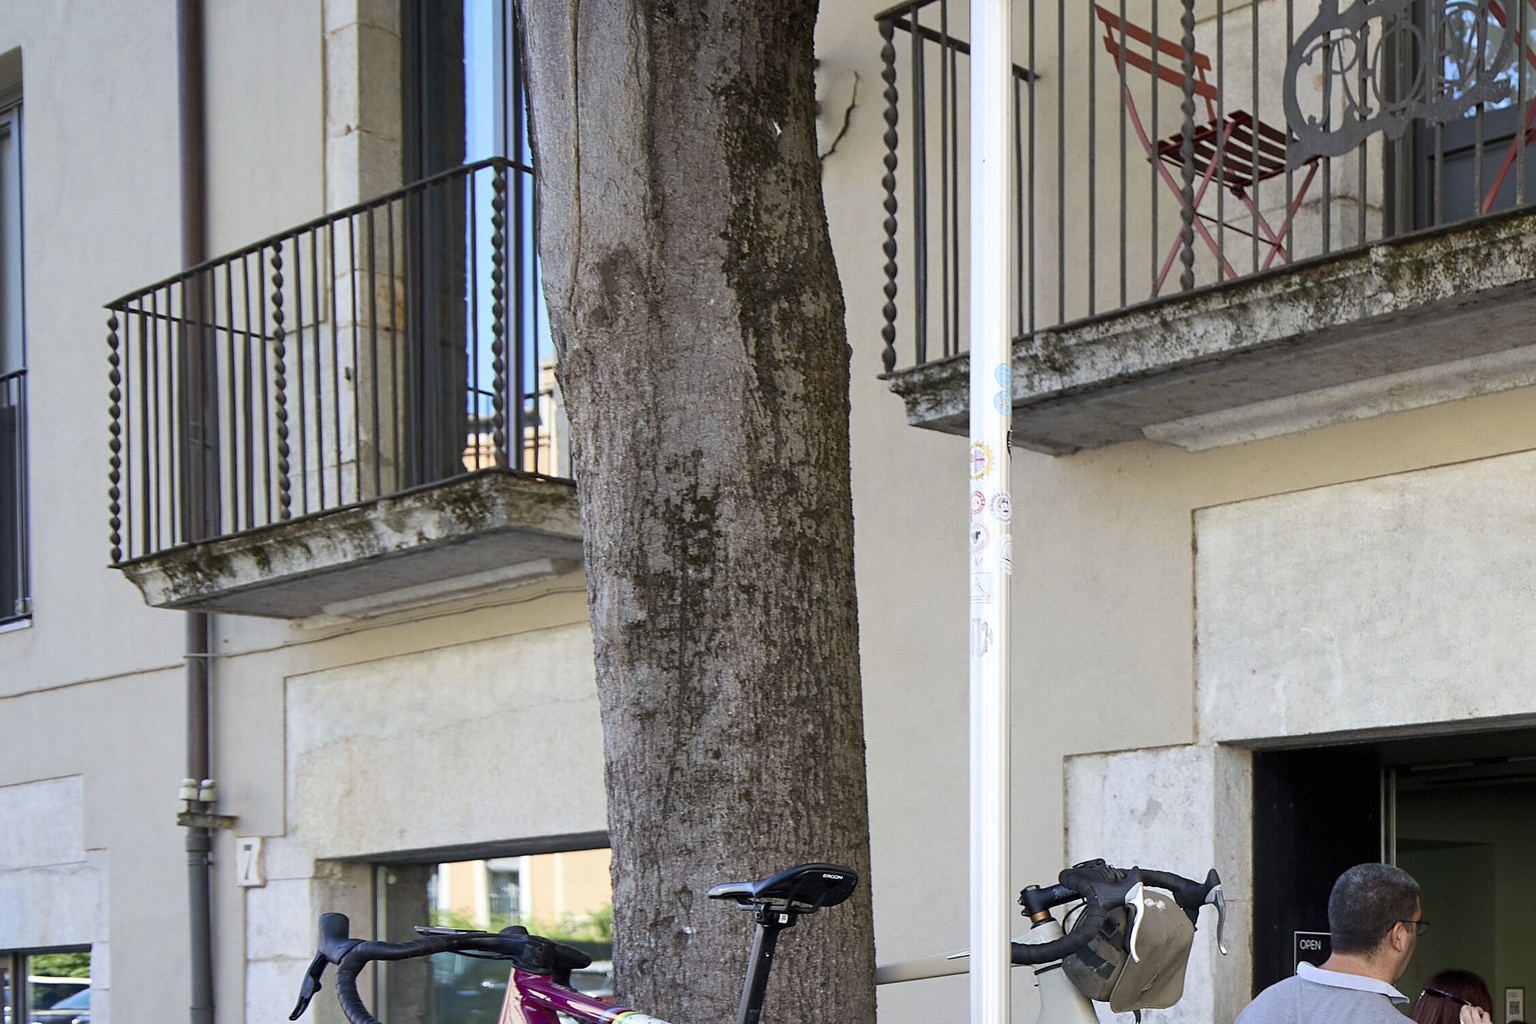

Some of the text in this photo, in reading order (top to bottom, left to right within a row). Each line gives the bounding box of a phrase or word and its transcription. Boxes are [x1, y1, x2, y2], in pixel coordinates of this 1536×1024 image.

[244, 844, 253, 880] 7
[822, 872, 844, 880] ERGON
[1299, 939, 1322, 950] OPEN
